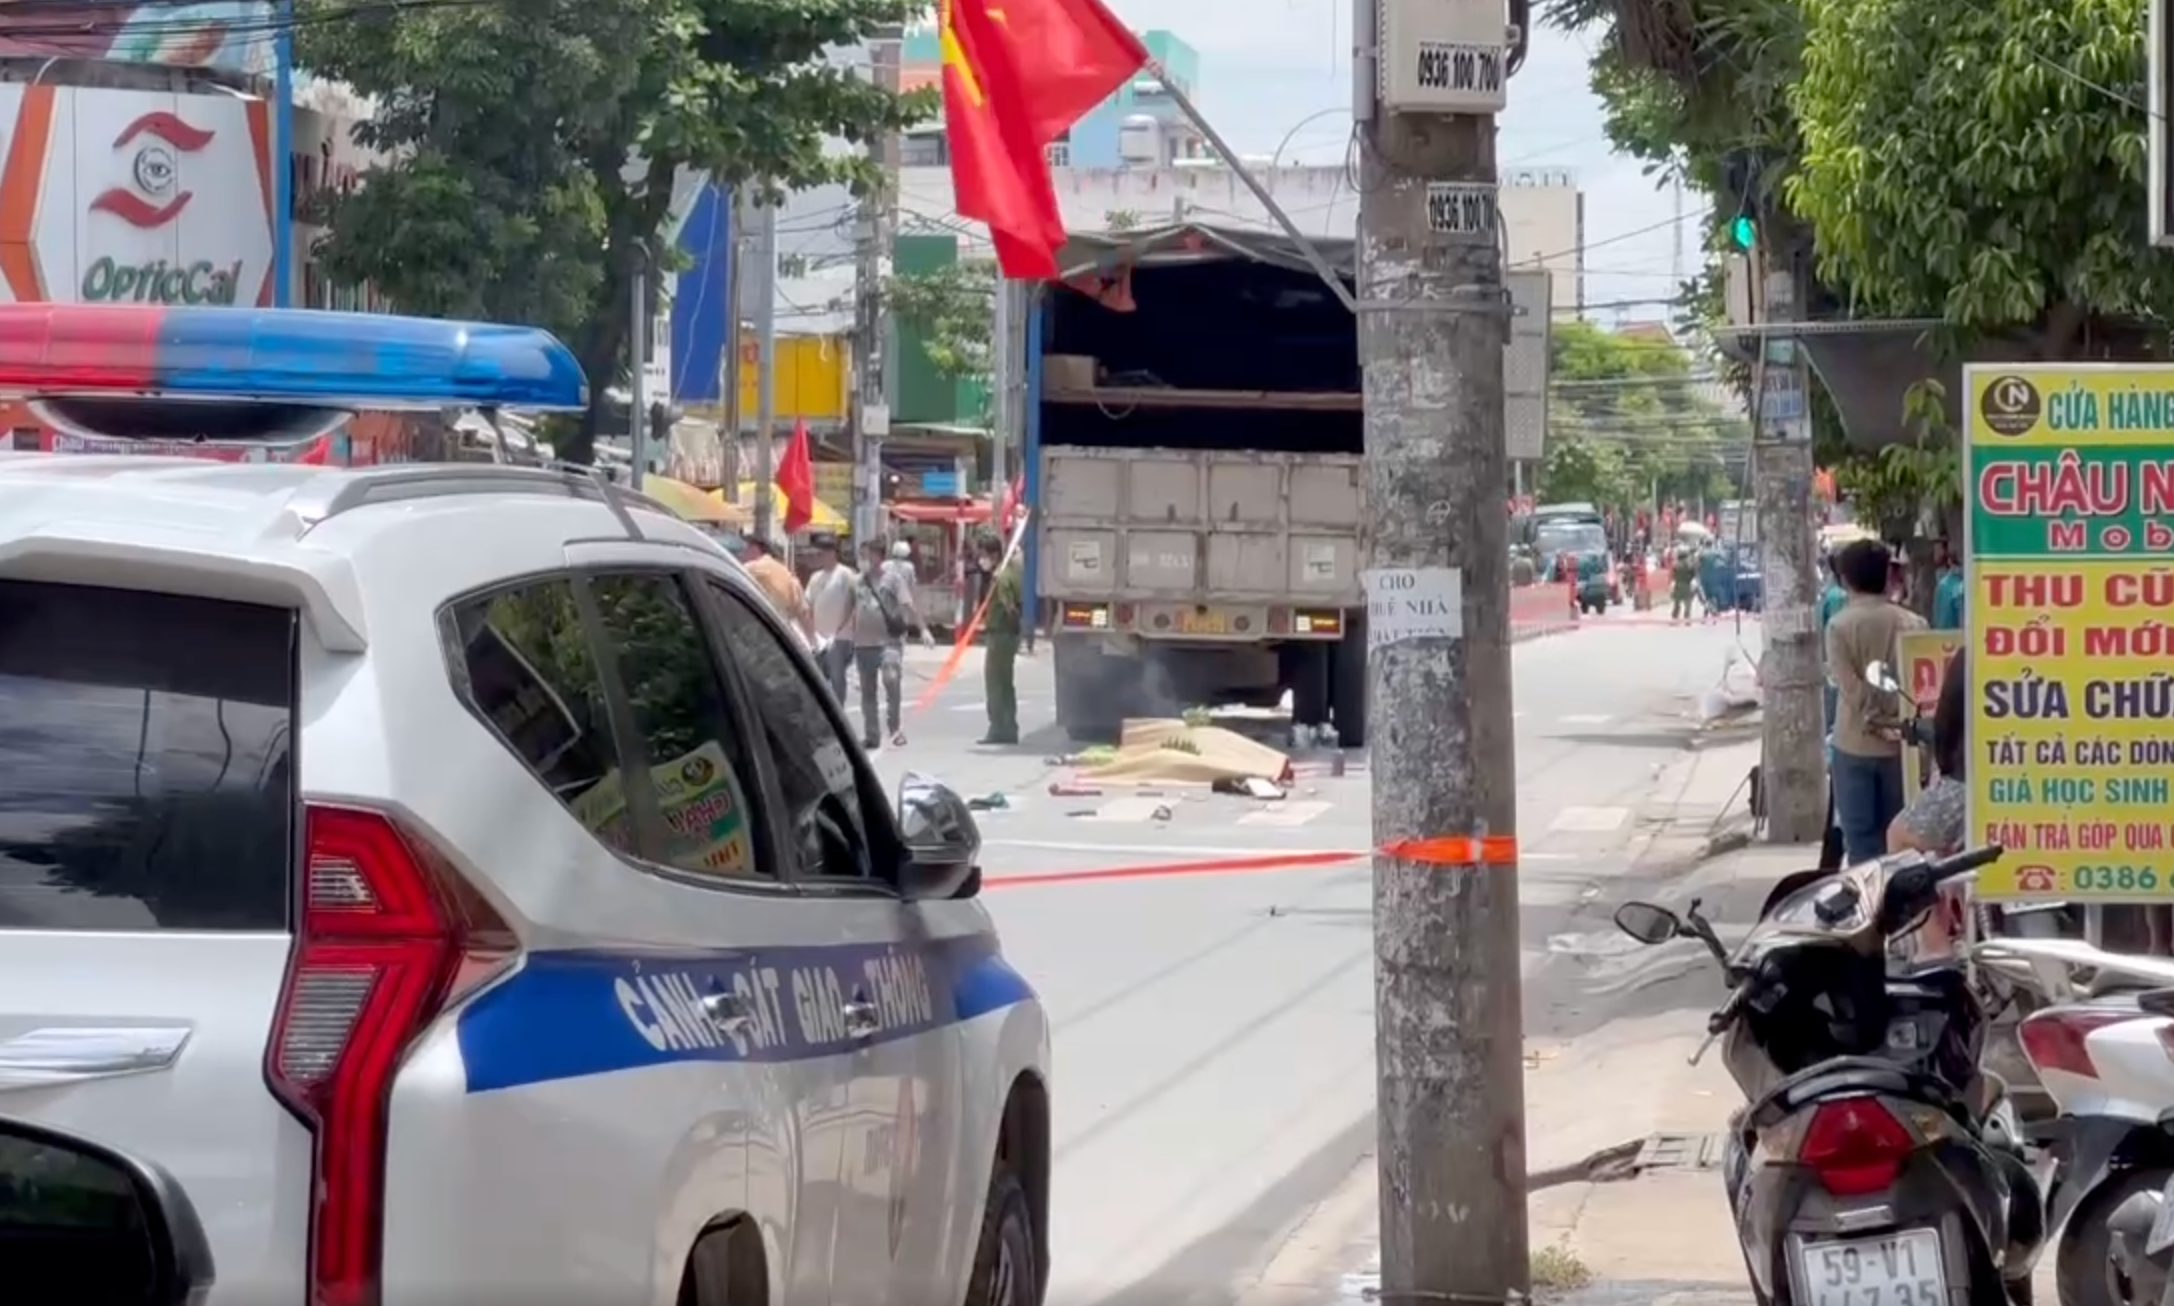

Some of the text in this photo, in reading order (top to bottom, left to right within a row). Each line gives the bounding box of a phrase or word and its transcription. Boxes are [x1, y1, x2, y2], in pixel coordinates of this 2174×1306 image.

[82, 255, 243, 306] OpticCal
[2047, 379, 2099, 431] CỬA
[1980, 449, 2129, 516] CHÂU
[1379, 572, 1416, 591] CHO
[1982, 567, 2174, 608] THU CŨ
[1984, 614, 2174, 657] ĐỔI MỚI
[1983, 666, 2069, 719] SỬA
[2085, 672, 2174, 719] CHỮ
[1986, 731, 2027, 765] TẤT
[2035, 731, 2067, 765] CẢ
[2074, 735, 2121, 765] CÁC
[1989, 773, 2169, 810] GIÁ HỌC SINH
[1986, 817, 2027, 850] BÁN
[2033, 815, 2071, 850] TRẢ
[2077, 817, 2118, 850] GÓP
[2125, 822, 2163, 852] QUA
[2073, 864, 2158, 890] 0386
[1821, 1238, 1918, 1287] 59-V1
